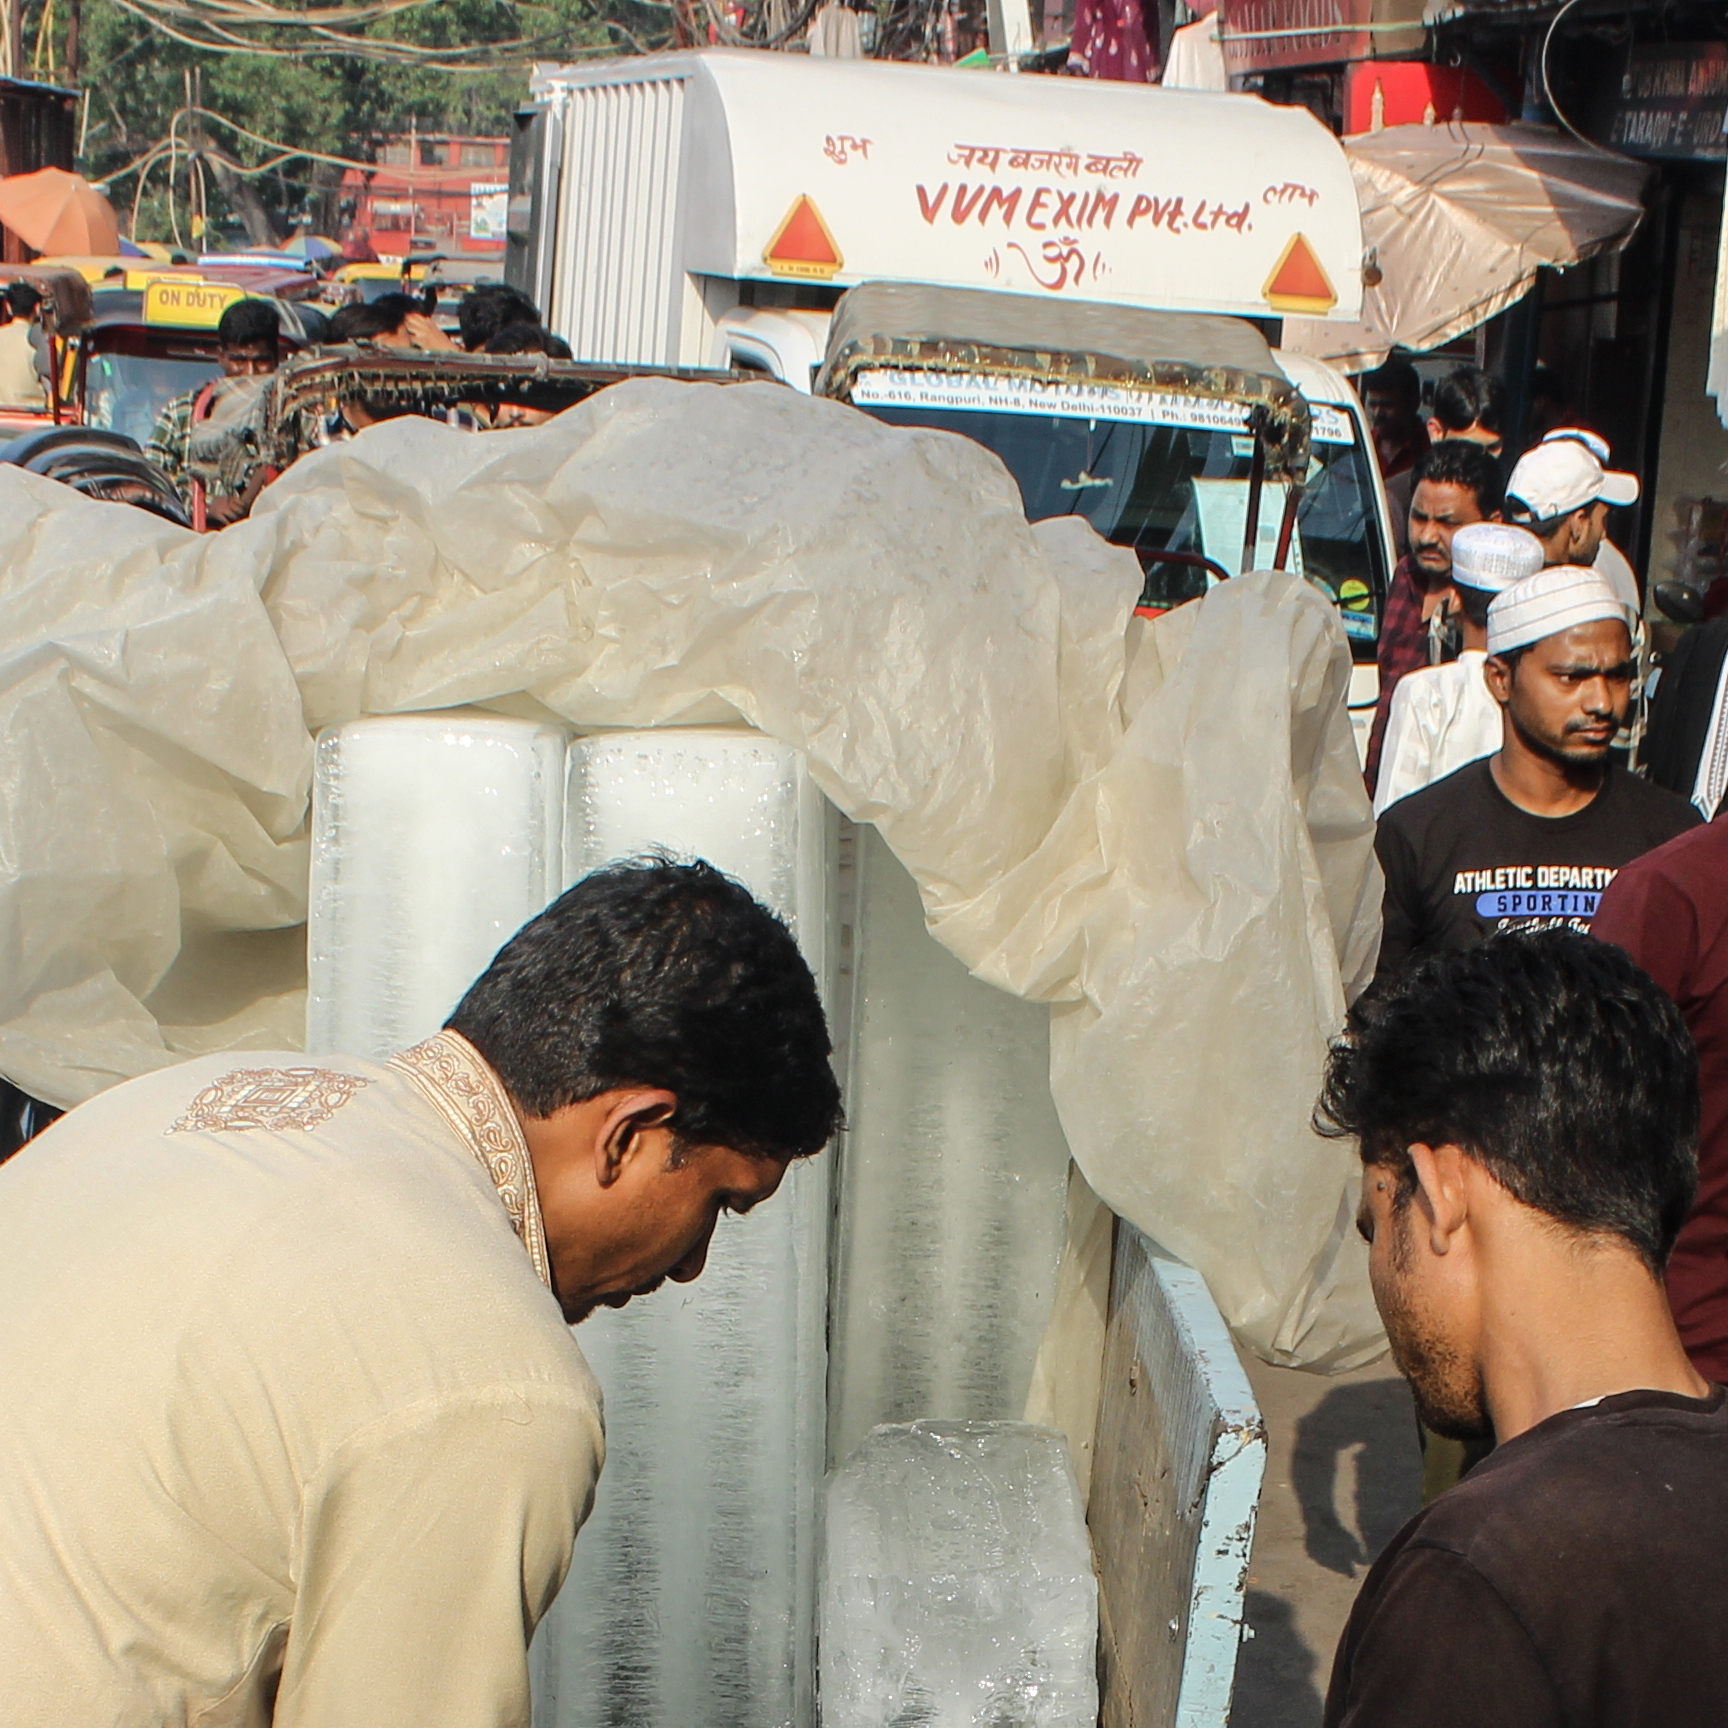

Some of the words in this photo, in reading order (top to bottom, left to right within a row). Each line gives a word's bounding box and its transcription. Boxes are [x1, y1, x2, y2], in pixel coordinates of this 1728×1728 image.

[947, 142, 1009, 175] जय
[1084, 150, 1144, 180] बली
[158, 288, 182, 306] ON
[185, 291, 228, 310] DUTY
[1029, 398, 1057, 411] New
[1453, 865, 1534, 895] ATHLETIC
